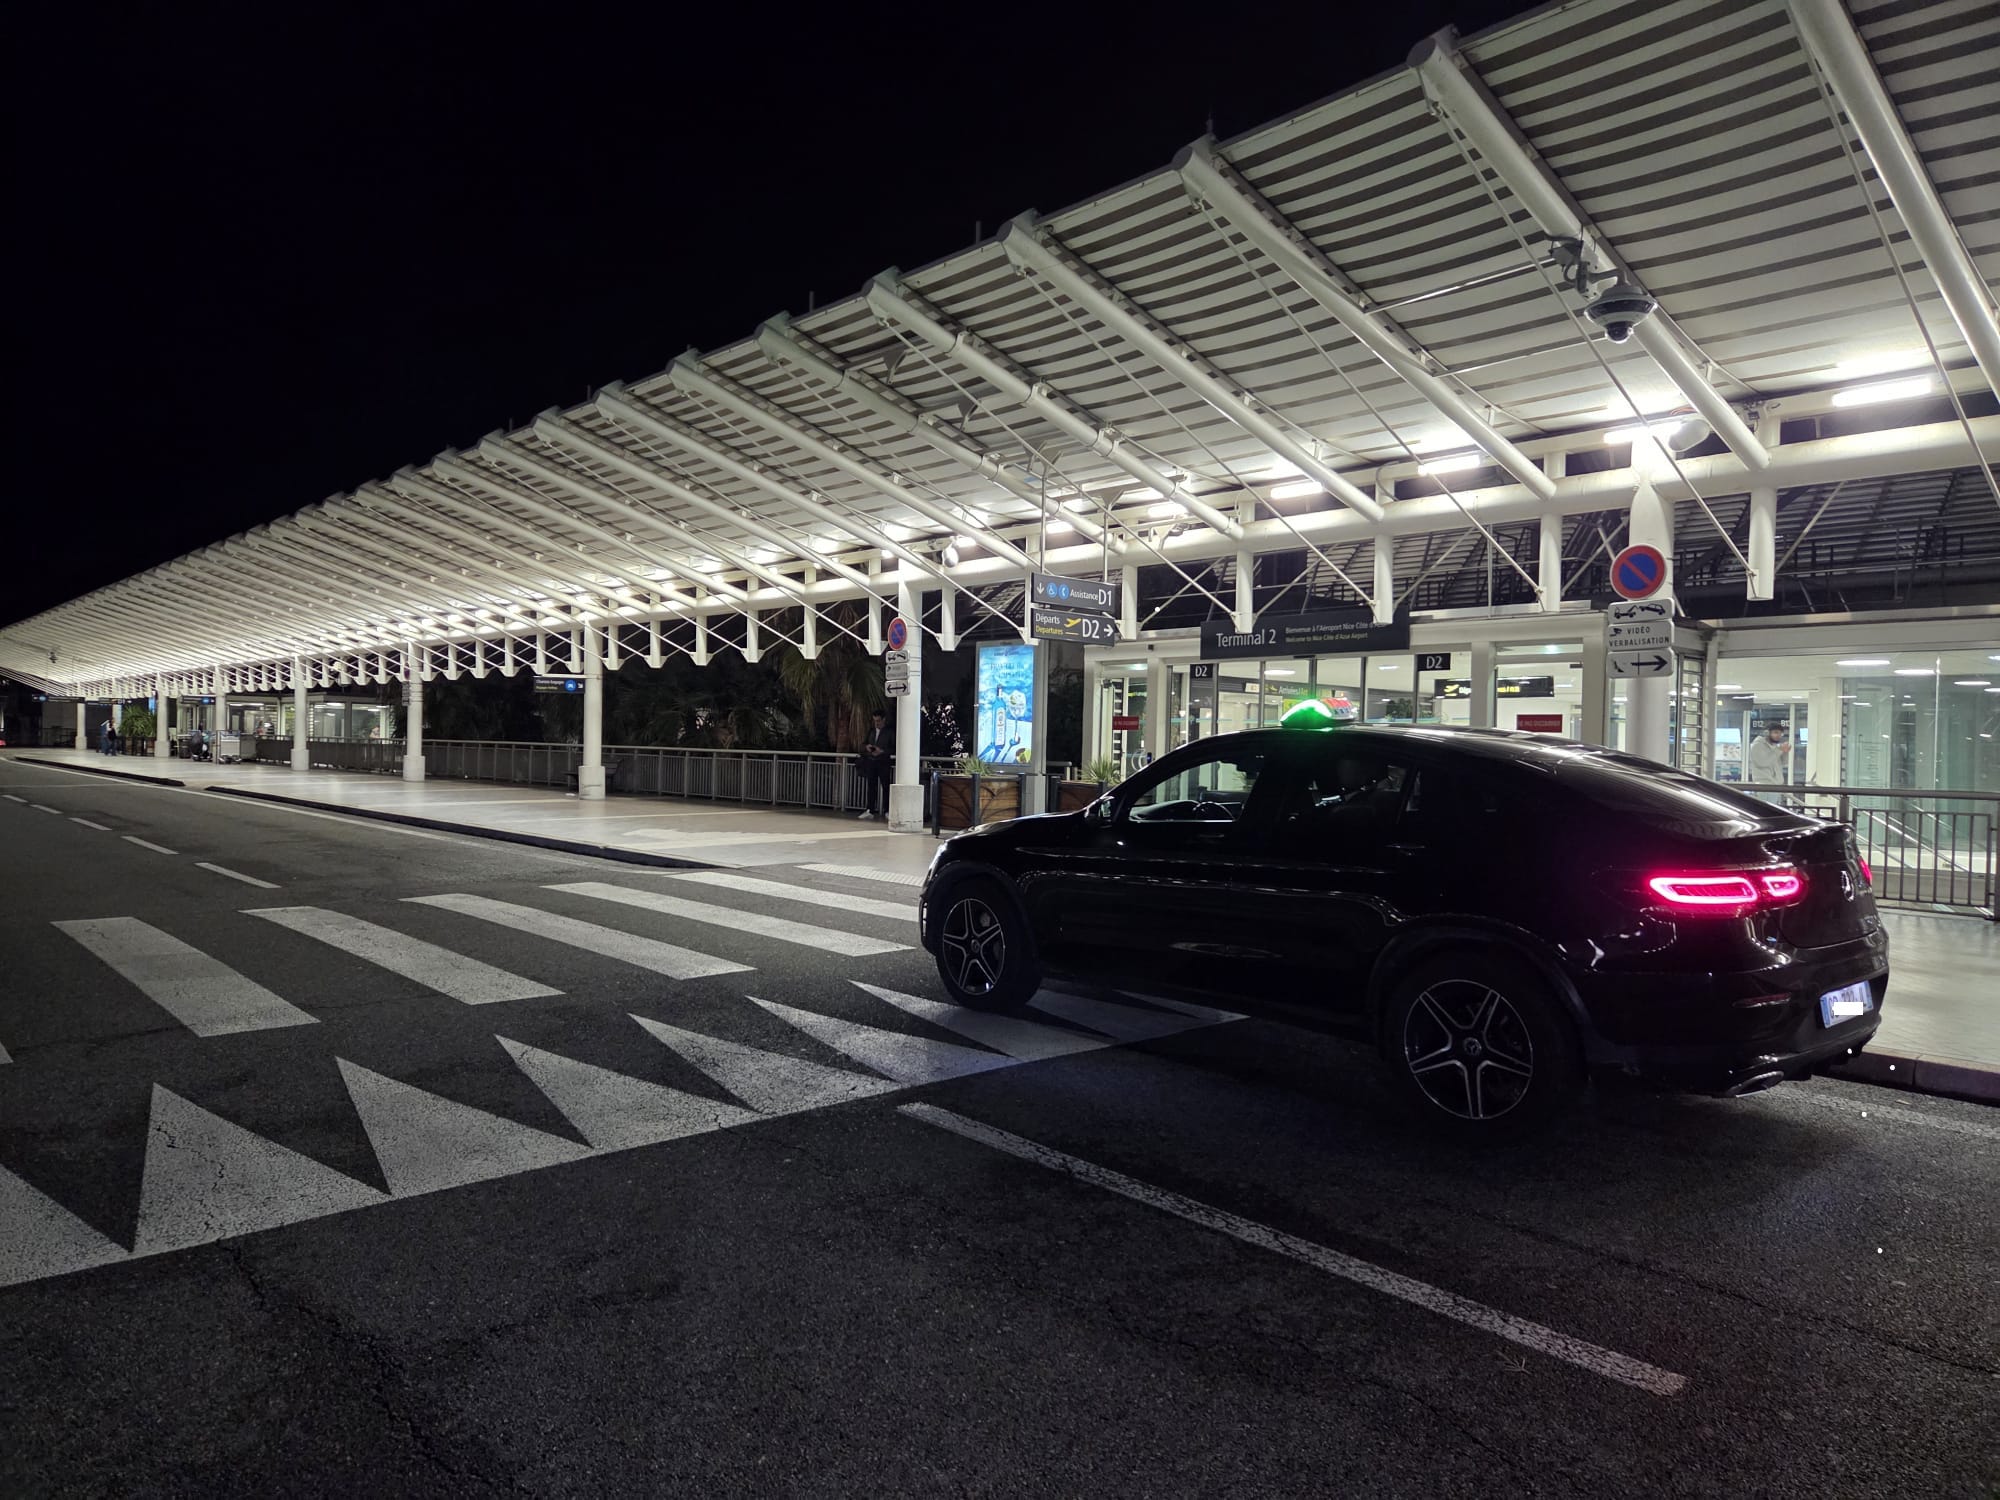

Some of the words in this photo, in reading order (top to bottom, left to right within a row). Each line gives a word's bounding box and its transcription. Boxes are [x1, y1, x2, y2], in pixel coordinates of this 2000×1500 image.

[1070, 588, 1098, 600] Assistance
[1098, 588, 1112, 606] D1
[1035, 612, 1060, 625] Départs
[1082, 618, 1100, 638] D2
[1035, 624, 1064, 635] Departures
[1627, 626, 1650, 635] VIDÉO
[1216, 628, 1265, 648] Terminal
[1268, 628, 1277, 644] 2
[1608, 636, 1670, 647] VERBALISATION
[1426, 655, 1443, 669] D2
[1195, 665, 1208, 677] D2
